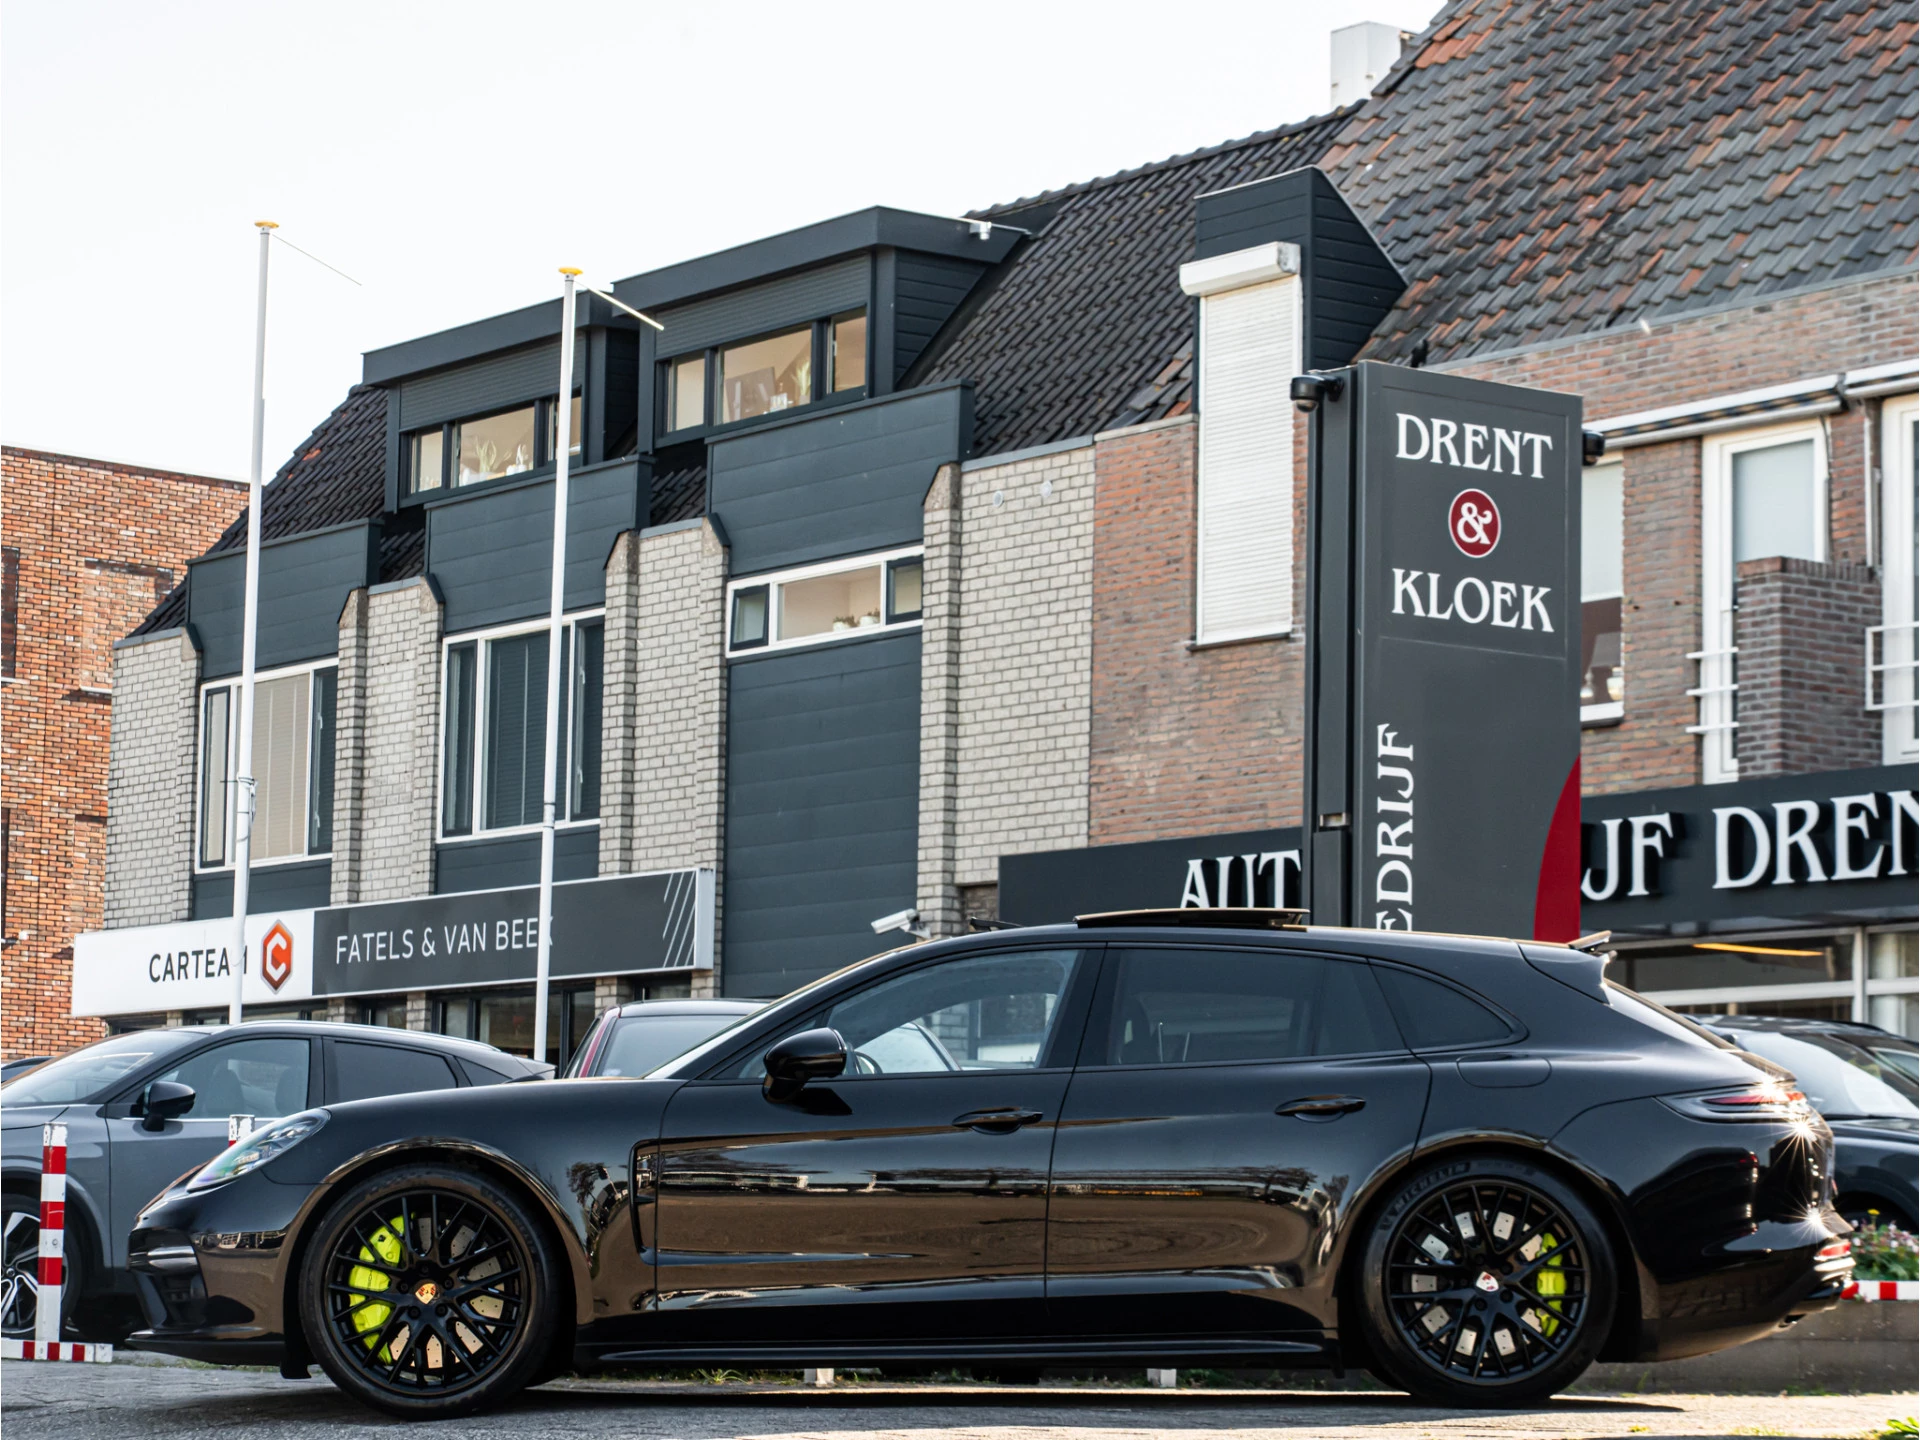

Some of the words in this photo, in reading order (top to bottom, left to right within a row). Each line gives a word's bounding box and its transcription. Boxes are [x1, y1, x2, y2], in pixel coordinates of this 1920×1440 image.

[1396, 412, 1553, 479] DRENT
[1457, 502, 1493, 545] &
[1392, 568, 1554, 633] KLOEK
[149, 945, 248, 982] CARTEA
[336, 929, 413, 964] FATELS
[421, 926, 436, 957] &
[444, 922, 487, 954] VAN
[496, 916, 553, 950] BEE
